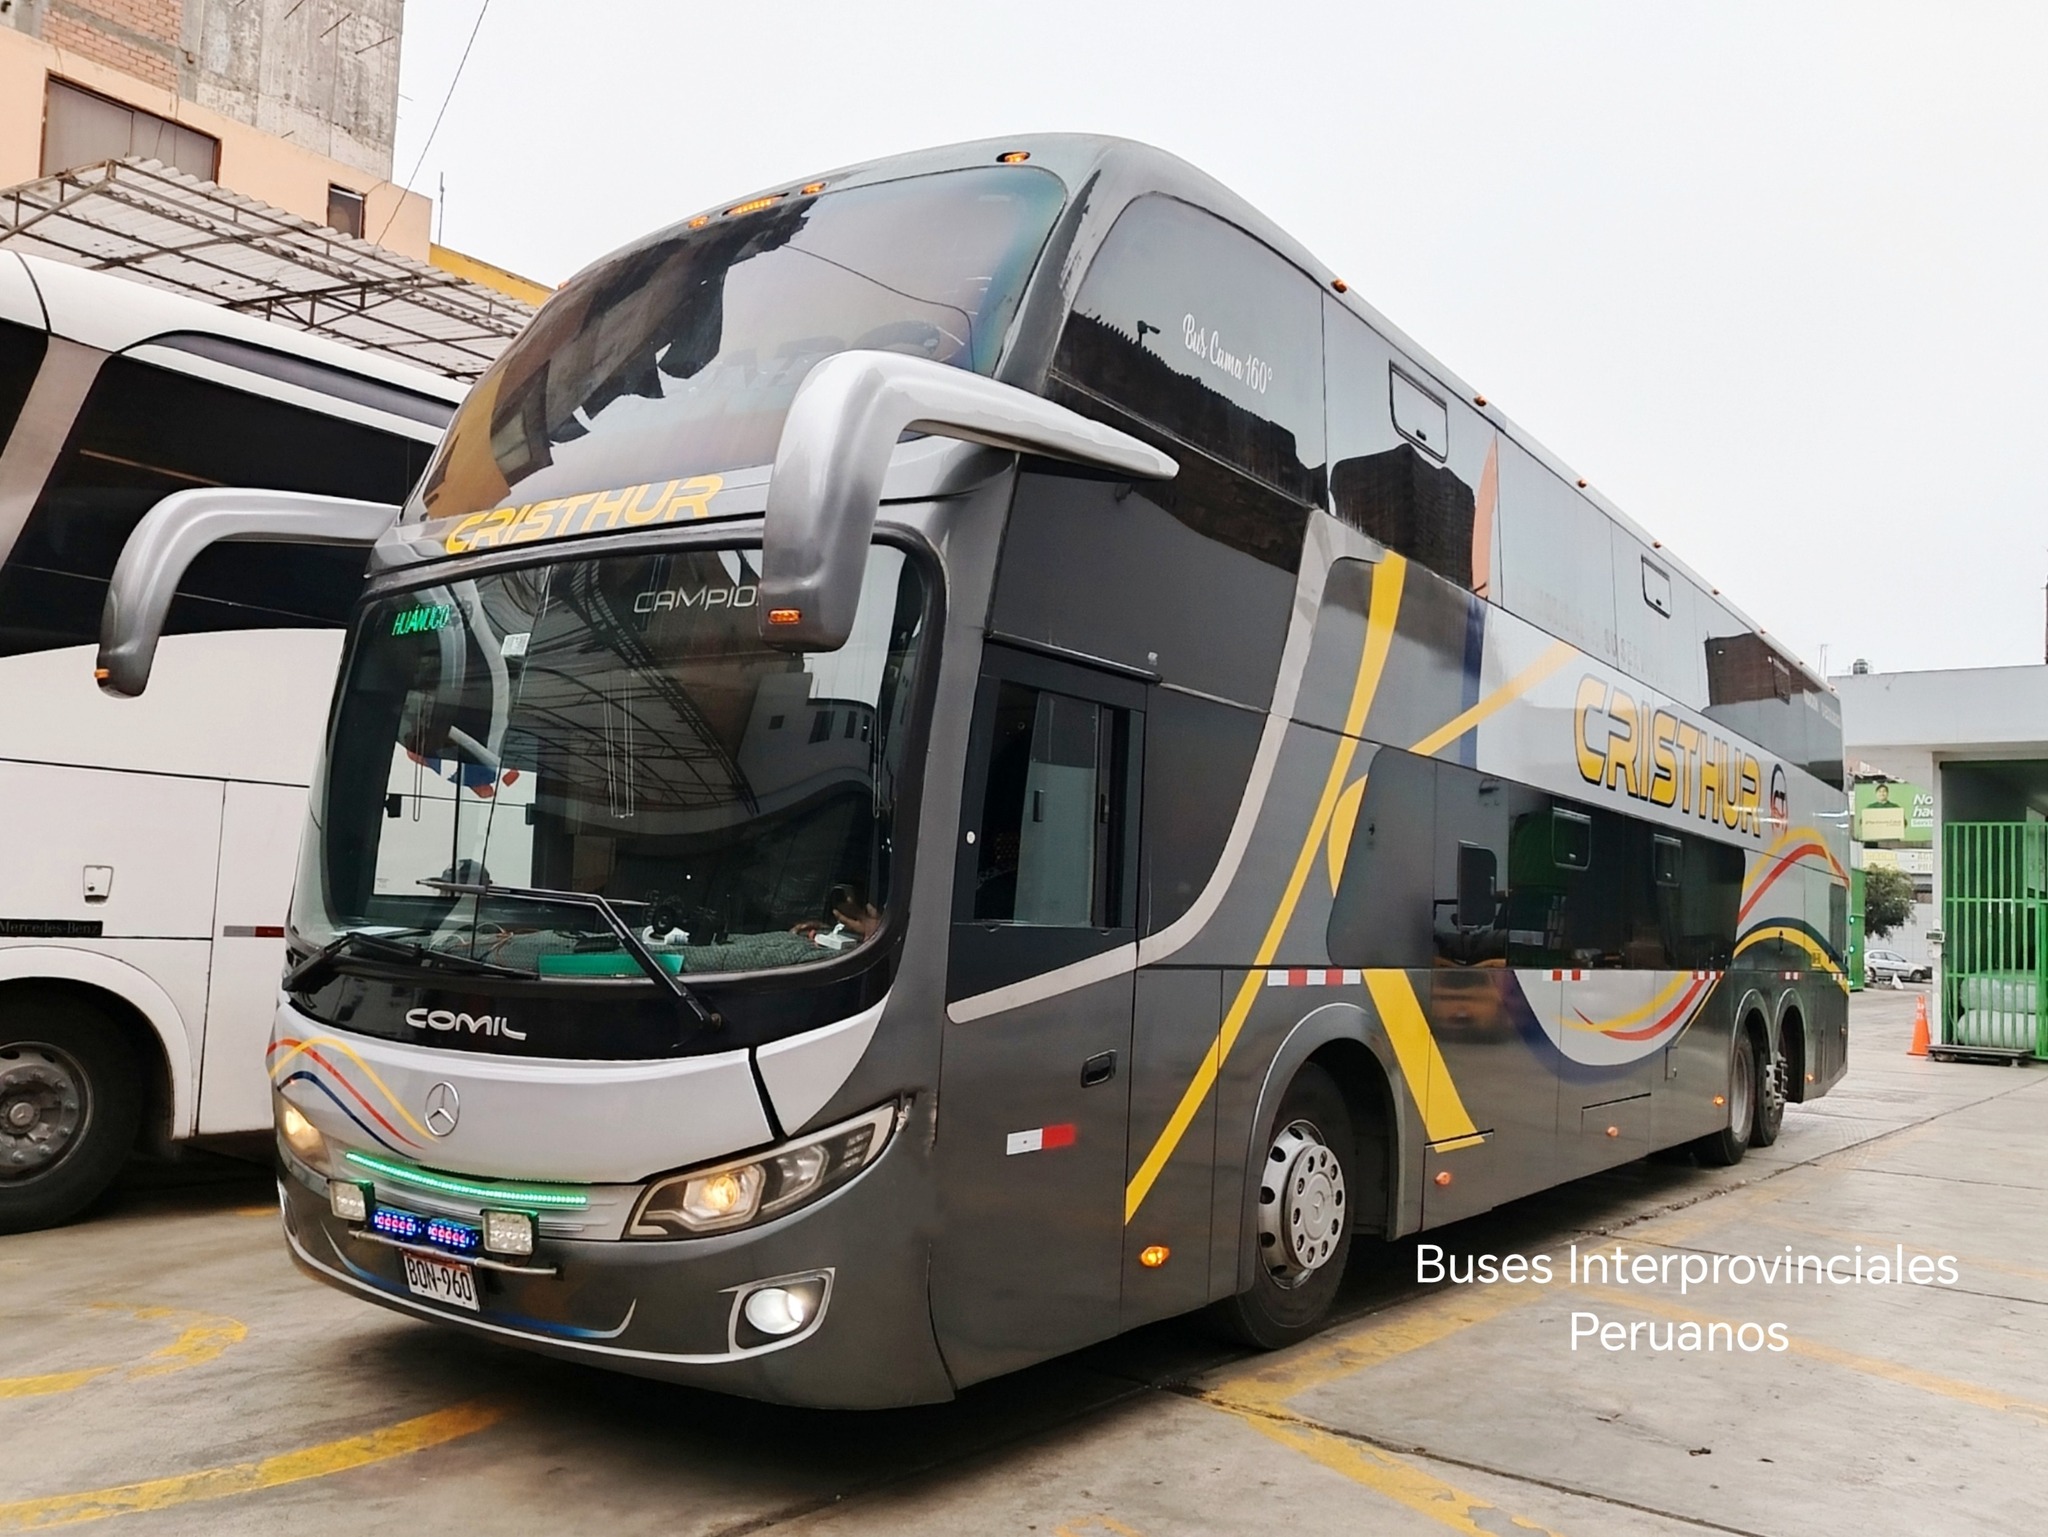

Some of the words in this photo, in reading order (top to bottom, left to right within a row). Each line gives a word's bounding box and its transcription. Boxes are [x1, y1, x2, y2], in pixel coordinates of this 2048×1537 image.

[1183, 313, 1208, 359] Bus
[1209, 330, 1245, 380] Cama
[445, 474, 723, 554] CRISTHUR
[633, 584, 763, 614] CAMPIO
[1574, 672, 1762, 838] CRISTHUR
[0, 920, 99, 934] Mercedes-Benz
[405, 1008, 527, 1040] COMIL
